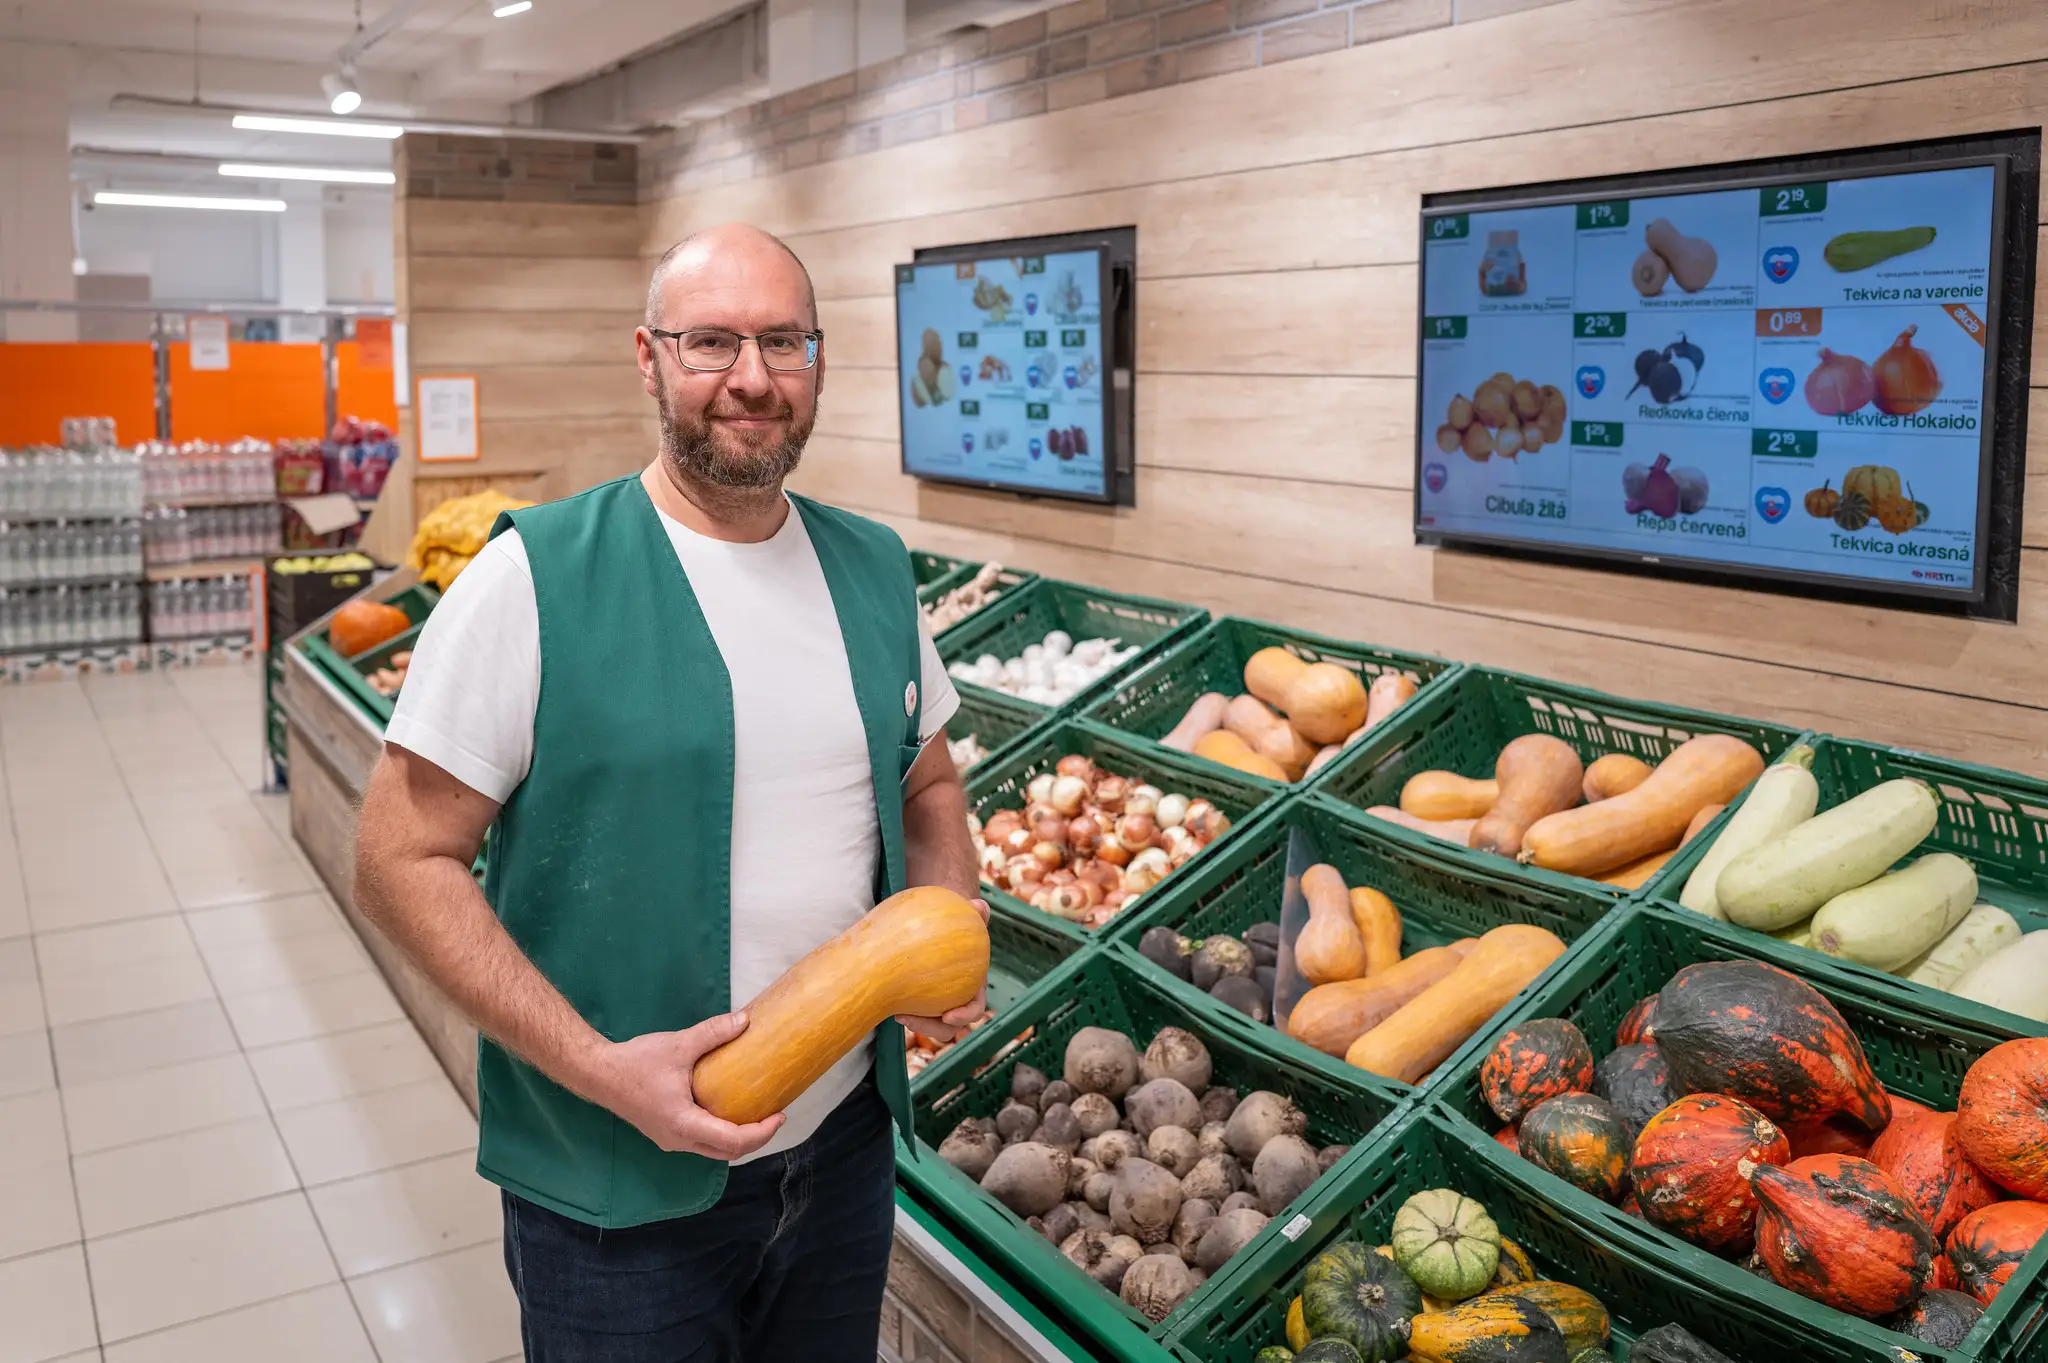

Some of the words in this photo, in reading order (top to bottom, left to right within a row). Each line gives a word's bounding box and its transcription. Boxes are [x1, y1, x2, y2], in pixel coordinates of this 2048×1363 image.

[1842, 286, 1900, 302] Tekvica
[1903, 287, 1922, 300] na
[1925, 283, 1984, 299] varenie
[1706, 406, 1750, 422] čierna
[1836, 410, 1899, 428] Tekvica
[1903, 412, 1977, 430] Hokaido
[1538, 498, 1567, 519] žltá
[1637, 513, 1677, 533] Repa
[1680, 516, 1746, 539] červená
[1830, 533, 1894, 555] Tekvica
[1897, 540, 1970, 562] okrasná
